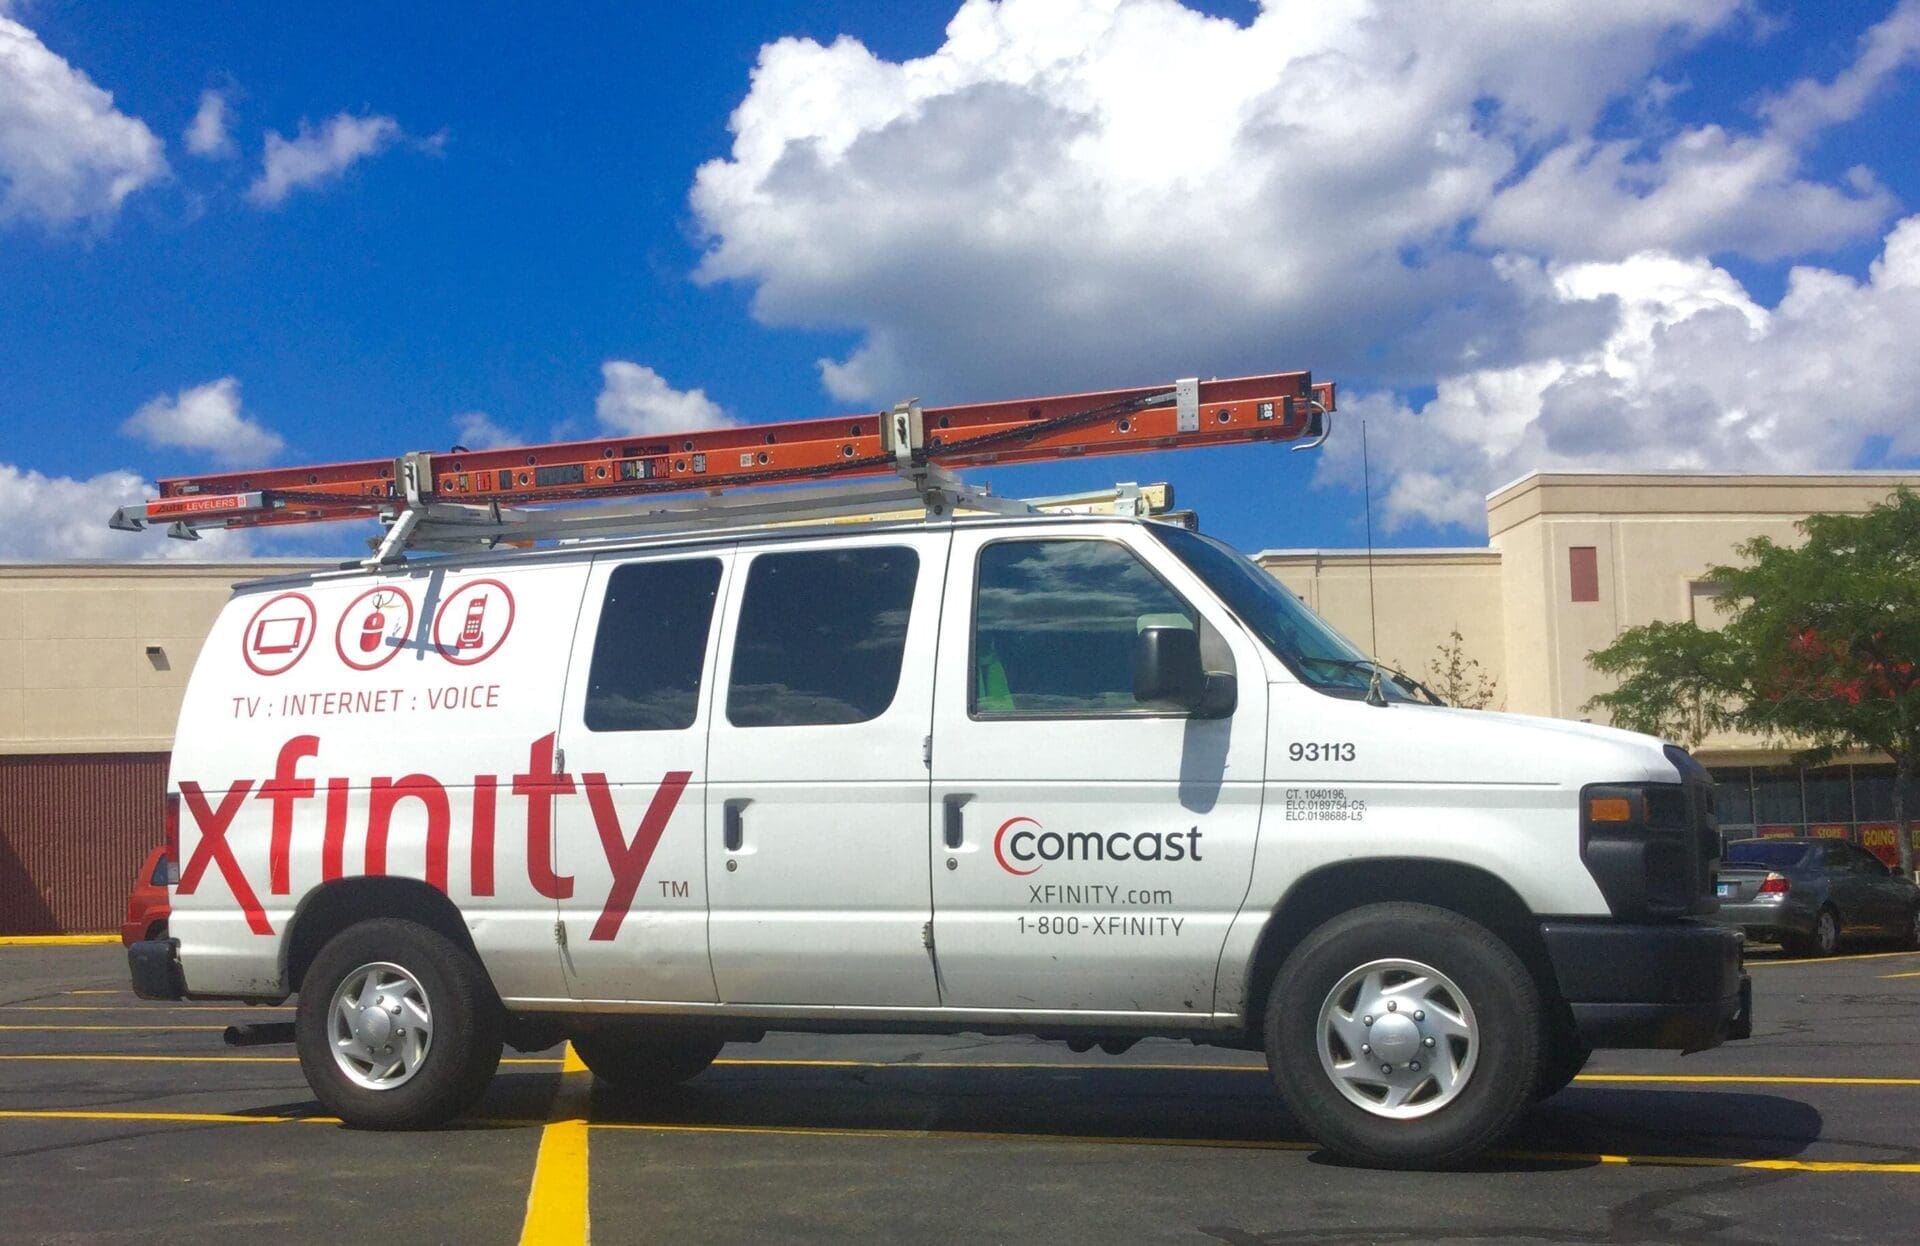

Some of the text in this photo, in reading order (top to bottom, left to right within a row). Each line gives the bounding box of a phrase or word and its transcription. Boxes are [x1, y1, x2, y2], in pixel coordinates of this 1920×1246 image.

[186, 498, 235, 511] LEVELERS
[233, 697, 260, 718] TV
[282, 690, 403, 716] INTERNET
[428, 685, 500, 710] VOICE
[1289, 742, 1356, 761] 93113
[175, 731, 693, 941] xfinity
[1010, 825, 1203, 862] comcast
[1863, 830, 1896, 846] GOING
[659, 881, 689, 898] TM
[1029, 884, 1173, 905] XFINITY.com
[1017, 916, 1185, 937] 1-800-XFINITY
